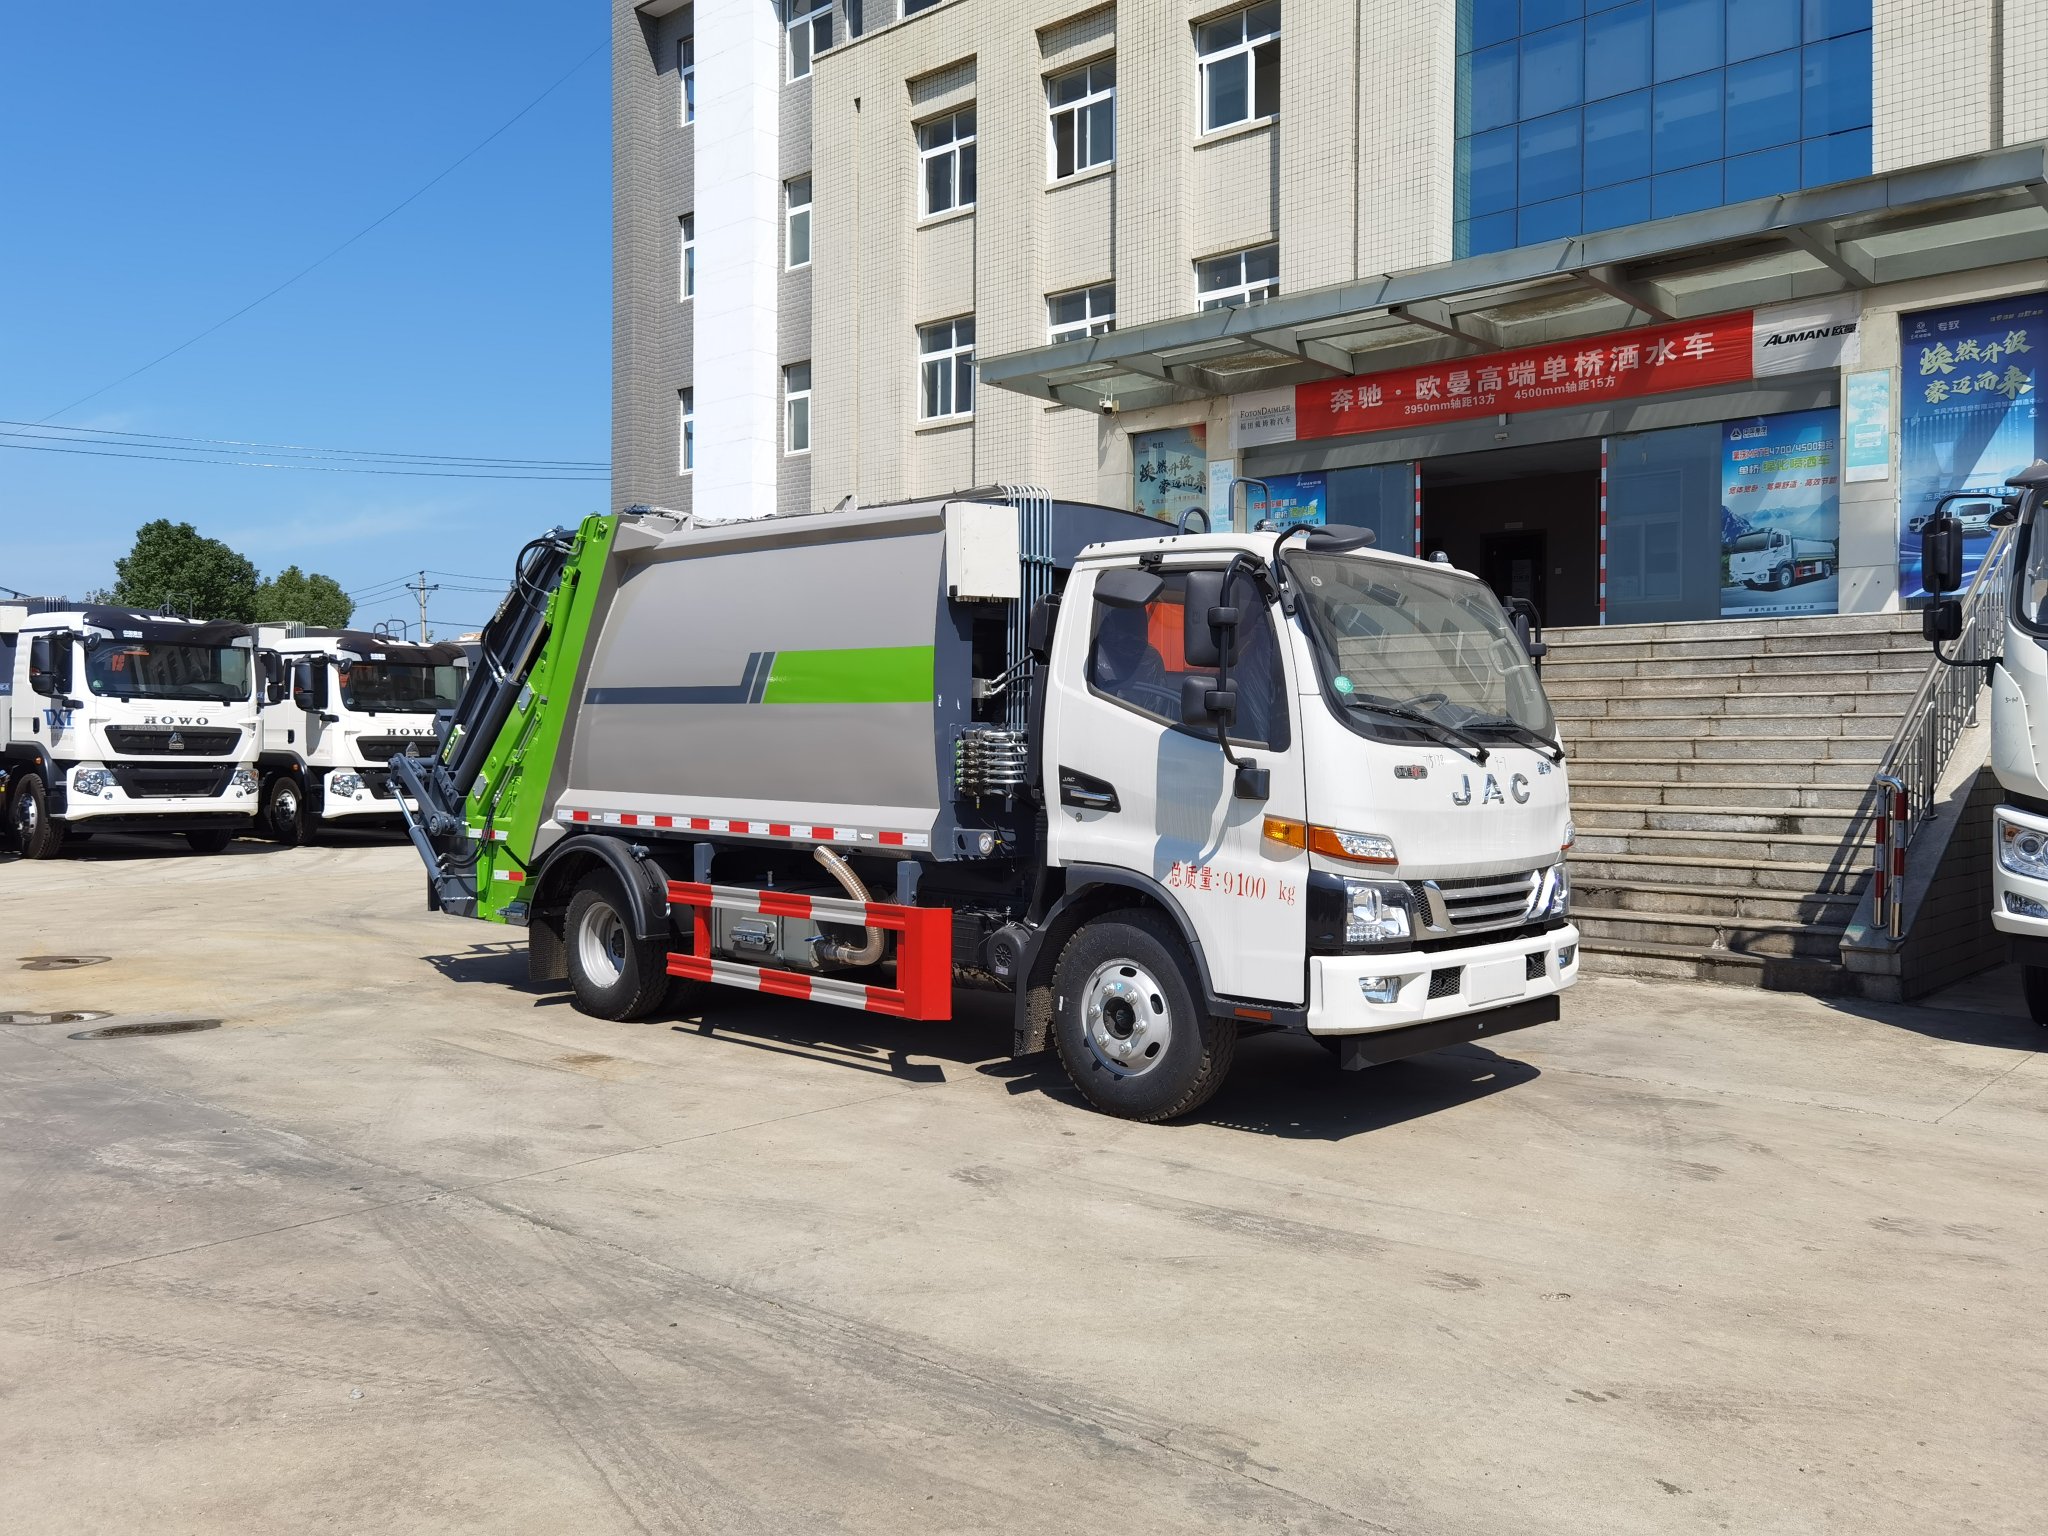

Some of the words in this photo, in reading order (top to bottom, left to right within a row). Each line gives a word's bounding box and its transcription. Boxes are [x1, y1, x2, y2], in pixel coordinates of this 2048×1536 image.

[1763, 327, 1830, 347] AUMAN
[1920, 330, 2034, 376] 焕然升级
[1405, 393, 1496, 415] 3950mm轴距13方
[1514, 375, 1616, 400] 4500mm轴距15方
[1924, 365, 2035, 404] 豪迈而来
[143, 715, 209, 726] HOWO
[387, 728, 436, 736] HOWO
[1452, 772, 1530, 806] JAC
[1279, 880, 1295, 906] kg
